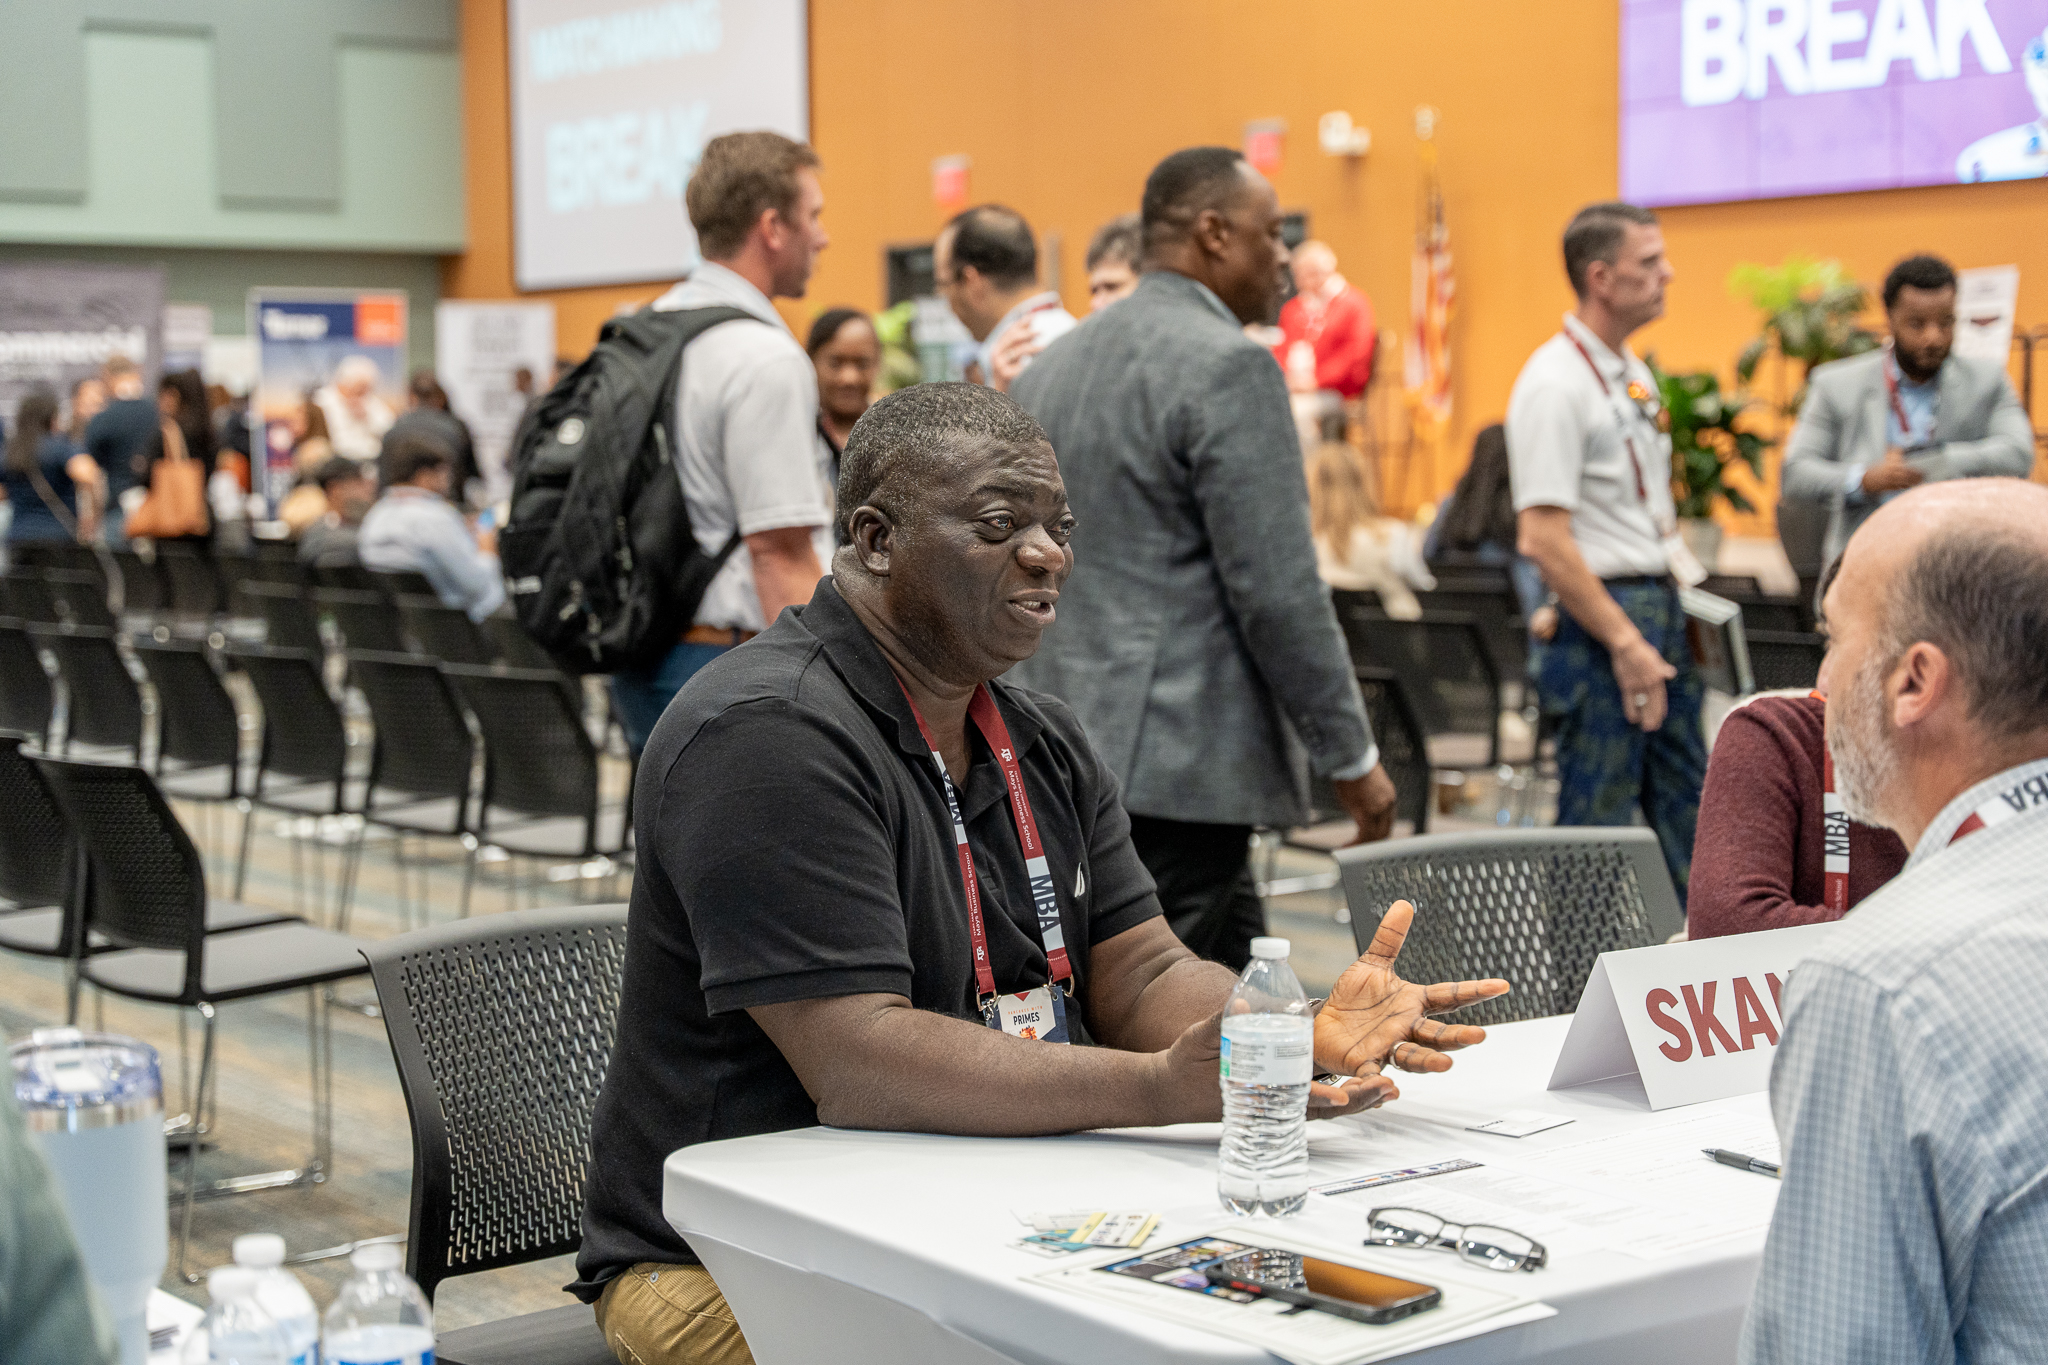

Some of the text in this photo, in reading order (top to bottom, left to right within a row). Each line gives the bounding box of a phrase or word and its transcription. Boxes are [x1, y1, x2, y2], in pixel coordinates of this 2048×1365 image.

[1681, 0, 2014, 107] BREAK
[1008, 770, 1034, 850] Mays Business School
[2000, 772, 2048, 813] BA
[1824, 811, 1850, 856] MBA
[964, 852, 982, 936] Mays Business School
[1030, 874, 1061, 933] MBA
[1013, 1012, 1040, 1026] PRIMES
